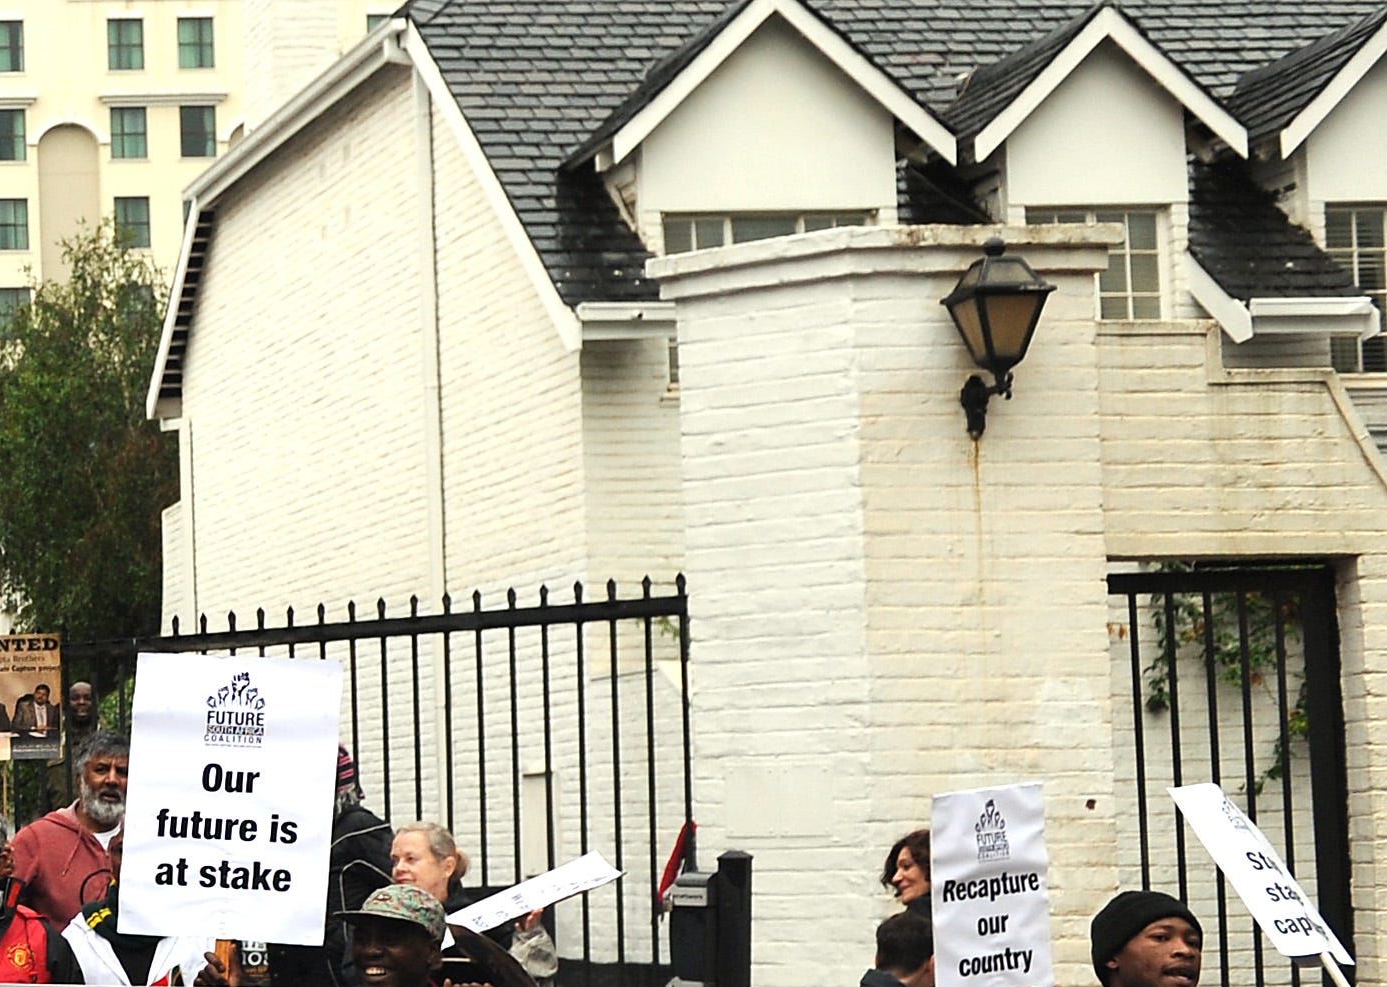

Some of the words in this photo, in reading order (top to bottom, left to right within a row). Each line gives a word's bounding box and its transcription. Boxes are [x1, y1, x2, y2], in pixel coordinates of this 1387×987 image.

[207, 710, 265, 727] FUTURE
[203, 734, 263, 744] COALITION
[201, 763, 261, 794] Our
[157, 808, 257, 842] future
[269, 814, 298, 844] is
[976, 830, 1007, 845] FUTURE
[155, 858, 189, 886] at
[199, 860, 291, 892] stake
[943, 872, 1039, 902] Recapture
[977, 914, 1009, 936] our
[959, 948, 1033, 977] country
